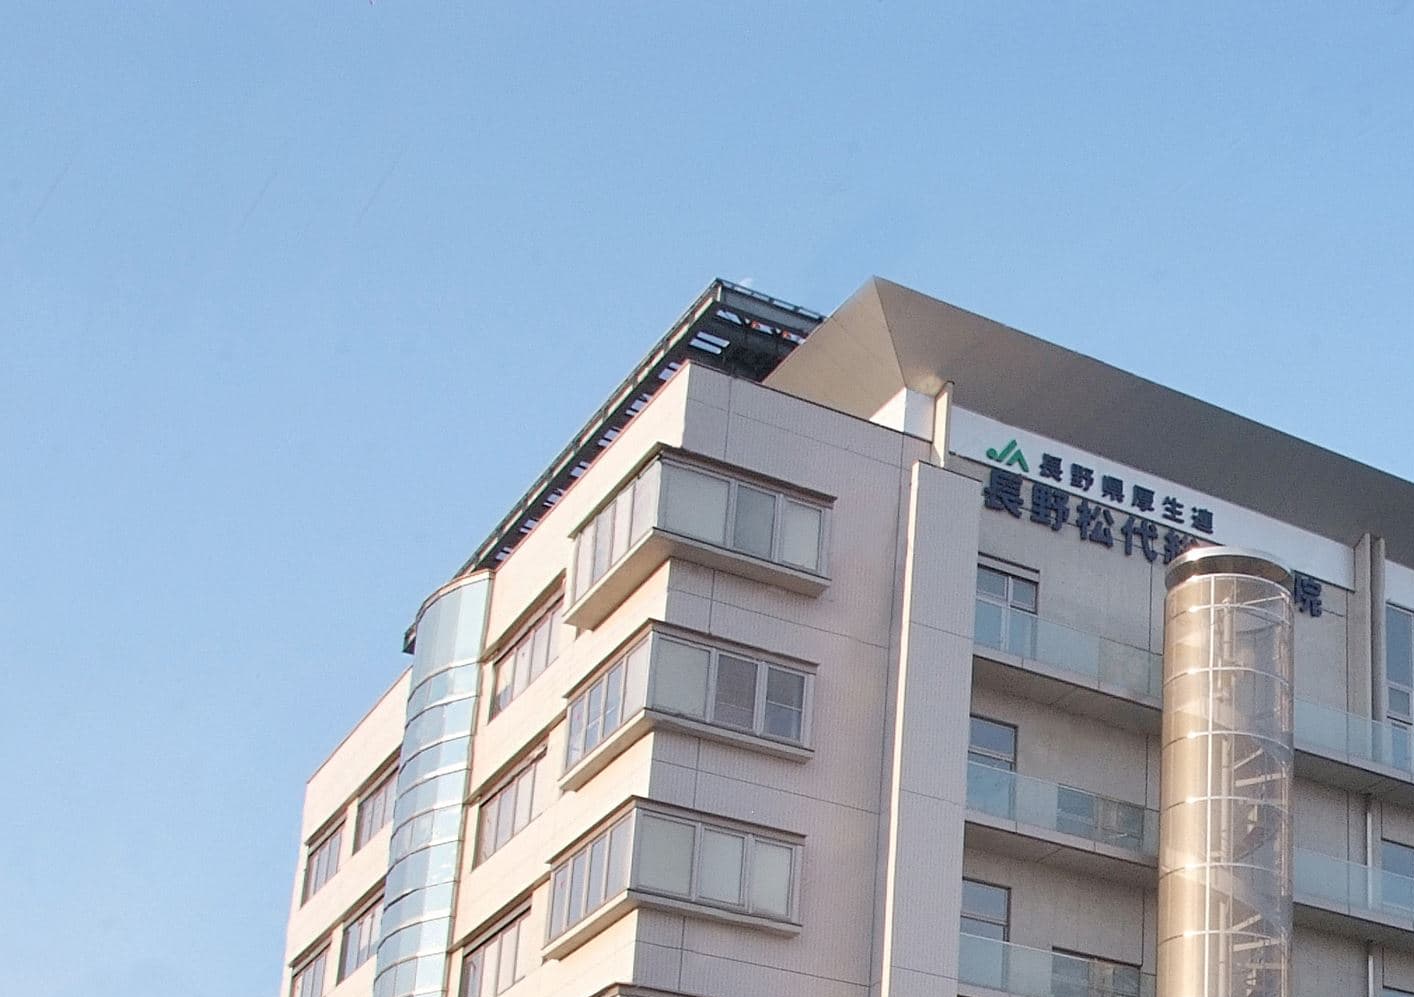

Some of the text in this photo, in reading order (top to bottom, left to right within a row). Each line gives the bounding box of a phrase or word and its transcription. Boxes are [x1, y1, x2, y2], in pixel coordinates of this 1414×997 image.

[1038, 452, 1214, 534] 長野県厚生連
